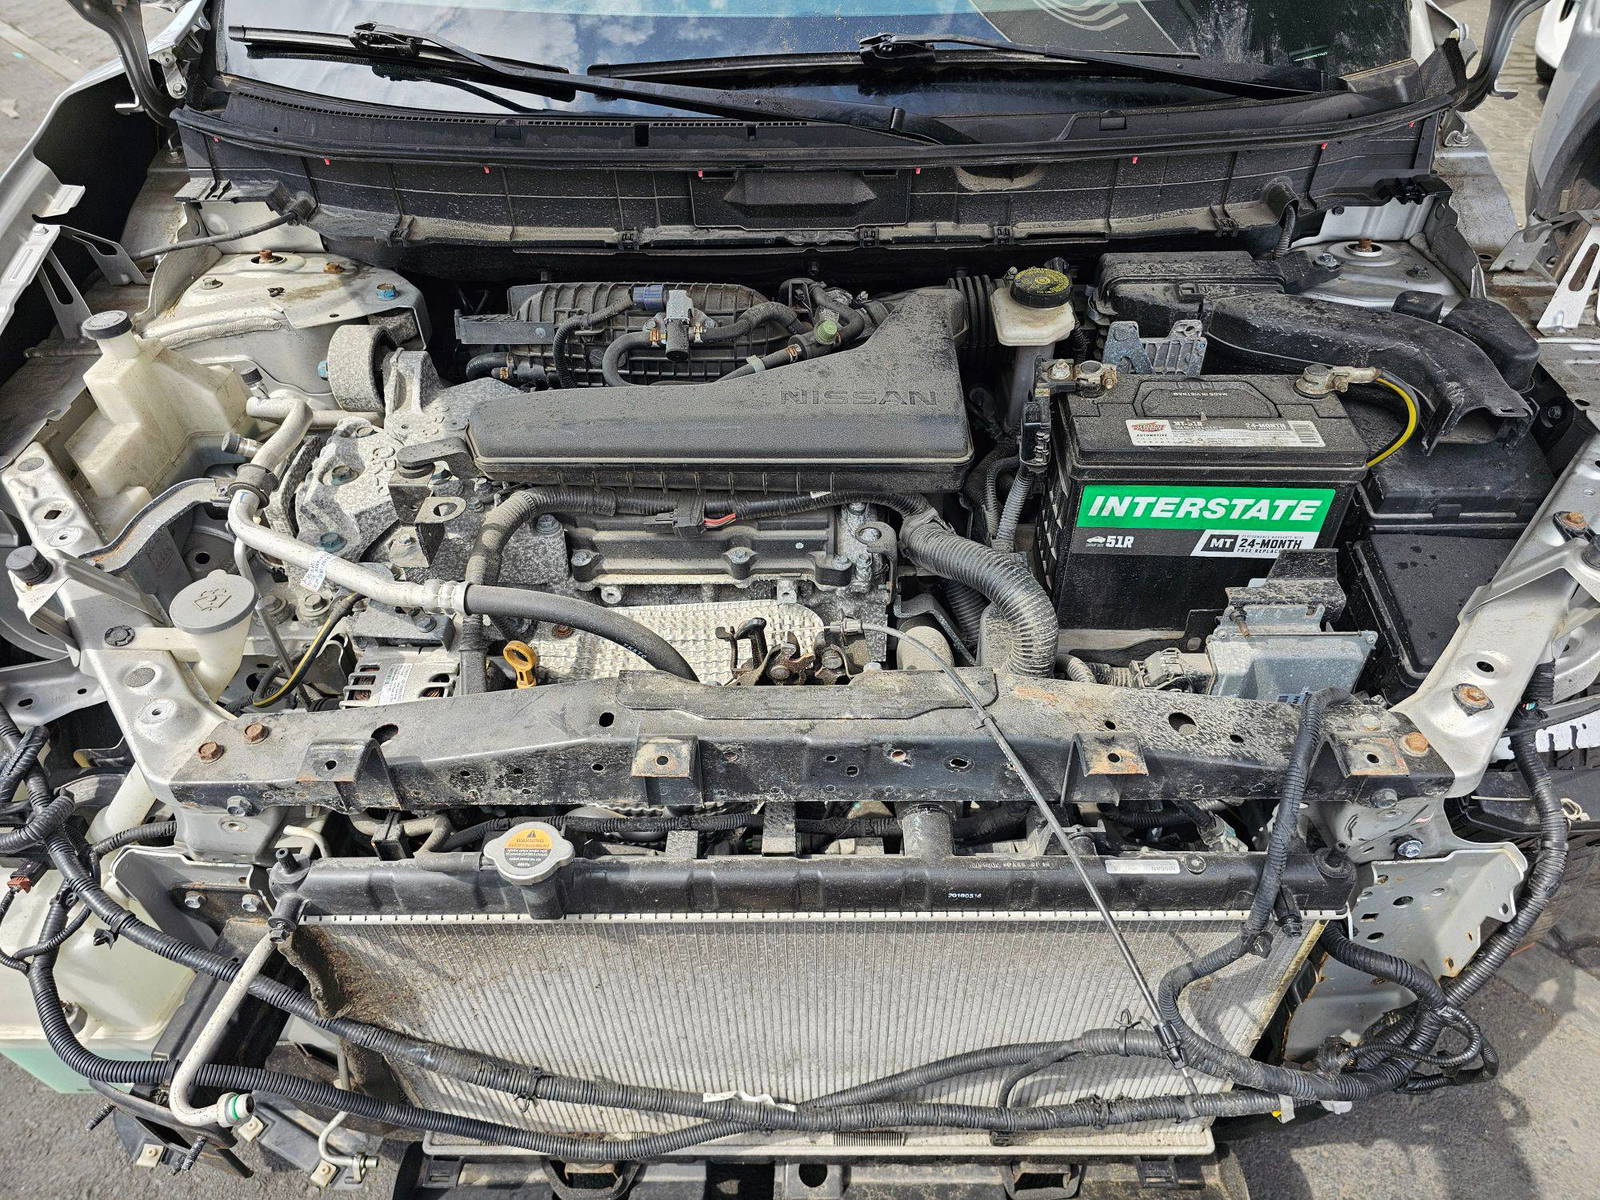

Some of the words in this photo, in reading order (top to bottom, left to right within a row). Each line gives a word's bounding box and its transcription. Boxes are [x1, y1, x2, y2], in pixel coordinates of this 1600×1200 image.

[780, 390, 938, 405] NISSAN
[1088, 495, 1322, 521] INTERSTATE
[1106, 535, 1134, 548] 51R
[1210, 538, 1234, 548] MT
[1239, 538, 1302, 550] 24-MONTH
